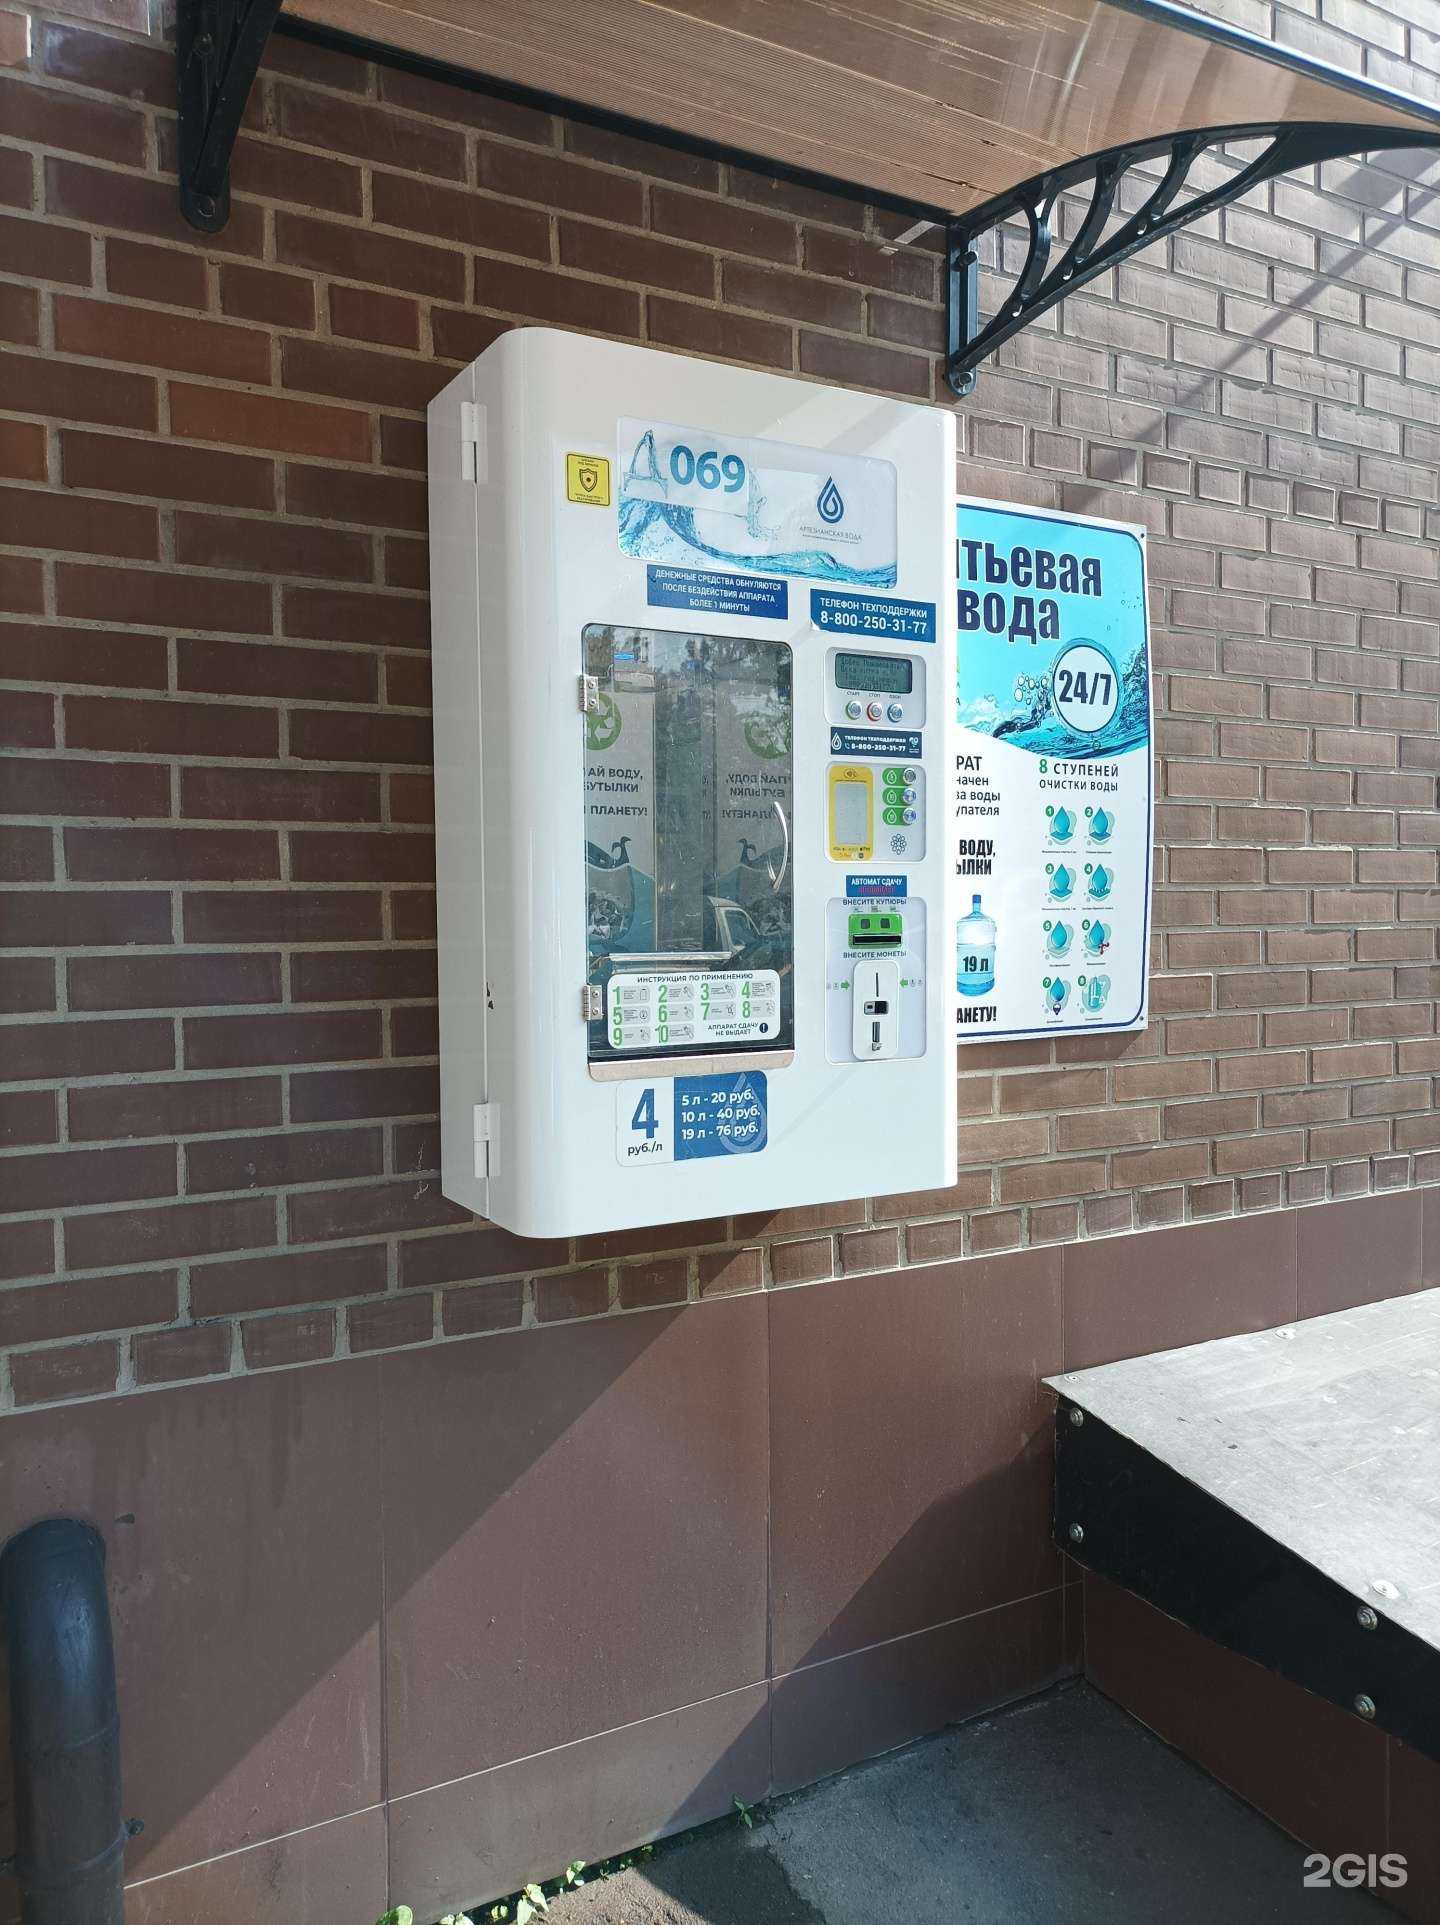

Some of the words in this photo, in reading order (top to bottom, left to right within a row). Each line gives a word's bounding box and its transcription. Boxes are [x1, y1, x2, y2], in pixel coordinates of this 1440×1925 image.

[670, 445, 746, 493] 069
[957, 539, 1101, 596] тьевая
[655, 569, 697, 581] ДЕНЕЖНЫЕ
[698, 574, 734, 586] СРЕДСТВА
[735, 579, 782, 591] ОБНУЛЯЮТСЯ
[662, 582, 687, 593] ПОСЛЕ
[688, 585, 738, 599] БЕЗДЕЙСТВИЯ
[738, 592, 776, 603] АППАРАТА
[689, 598, 713, 609] БОЛЕЕ
[713, 601, 718, 609] 1
[719, 602, 750, 612] МИНУТЫ
[820, 597, 860, 610] ТЕЛЕФОН
[860, 602, 928, 618] ТЕХПОДДЕРЖКИ
[820, 610, 927, 635] 8-800-250-31-77
[1058, 669, 1112, 706] 24/7
[608, 768, 643, 780] ВОДУ,
[1039, 759, 1048, 774] 8
[1053, 763, 1119, 777] СТУПЕНЕЙ
[1039, 779, 1087, 791] ОЧИСТКИ
[1090, 782, 1118, 793] ВОДЫ
[970, 791, 1001, 803] воды
[590, 805, 648, 816] ПЛАНЕТУ!
[959, 839, 996, 858] ВОДУ,
[851, 878, 881, 886] АВТОМАТ
[881, 878, 903, 886] СДАЧУ
[842, 898, 875, 906] ВНЕСИТЕ
[876, 950, 907, 958] МОНЕТЫ
[962, 956, 978, 972] 19
[980, 958, 989, 972] л
[637, 975, 687, 983] ИНСТРУКЦИЯ
[701, 973, 753, 981] ПРИМЕНЕНИЮ
[612, 986, 621, 1005] 1
[658, 985, 668, 1003] 2
[701, 983, 710, 1001] 3
[741, 982, 751, 999] 4
[612, 1006, 623, 1026] 5
[658, 1004, 668, 1023] 6
[701, 1003, 711, 1021] 7
[742, 1001, 751, 1019] 8
[707, 1023, 738, 1031] АППАРАТ
[738, 1022, 759, 1031] СДАЧУ
[715, 1029, 725, 1037] НЕ
[613, 1027, 623, 1046] 9
[655, 1025, 669, 1044] 10
[681, 1094, 690, 1106] 5
[691, 1095, 701, 1105] л
[711, 1092, 727, 1104] 20
[729, 1089, 755, 1104] руб.
[631, 1088, 659, 1138] 4
[681, 1111, 695, 1123] 10
[697, 1112, 706, 1122] л
[716, 1108, 733, 1120] 40
[735, 1107, 761, 1121] руб.
[681, 1128, 695, 1140] 19
[697, 1129, 706, 1139] л
[716, 1125, 731, 1137] 76
[734, 1122, 759, 1137] руб.
[628, 1141, 662, 1156] руб./л
